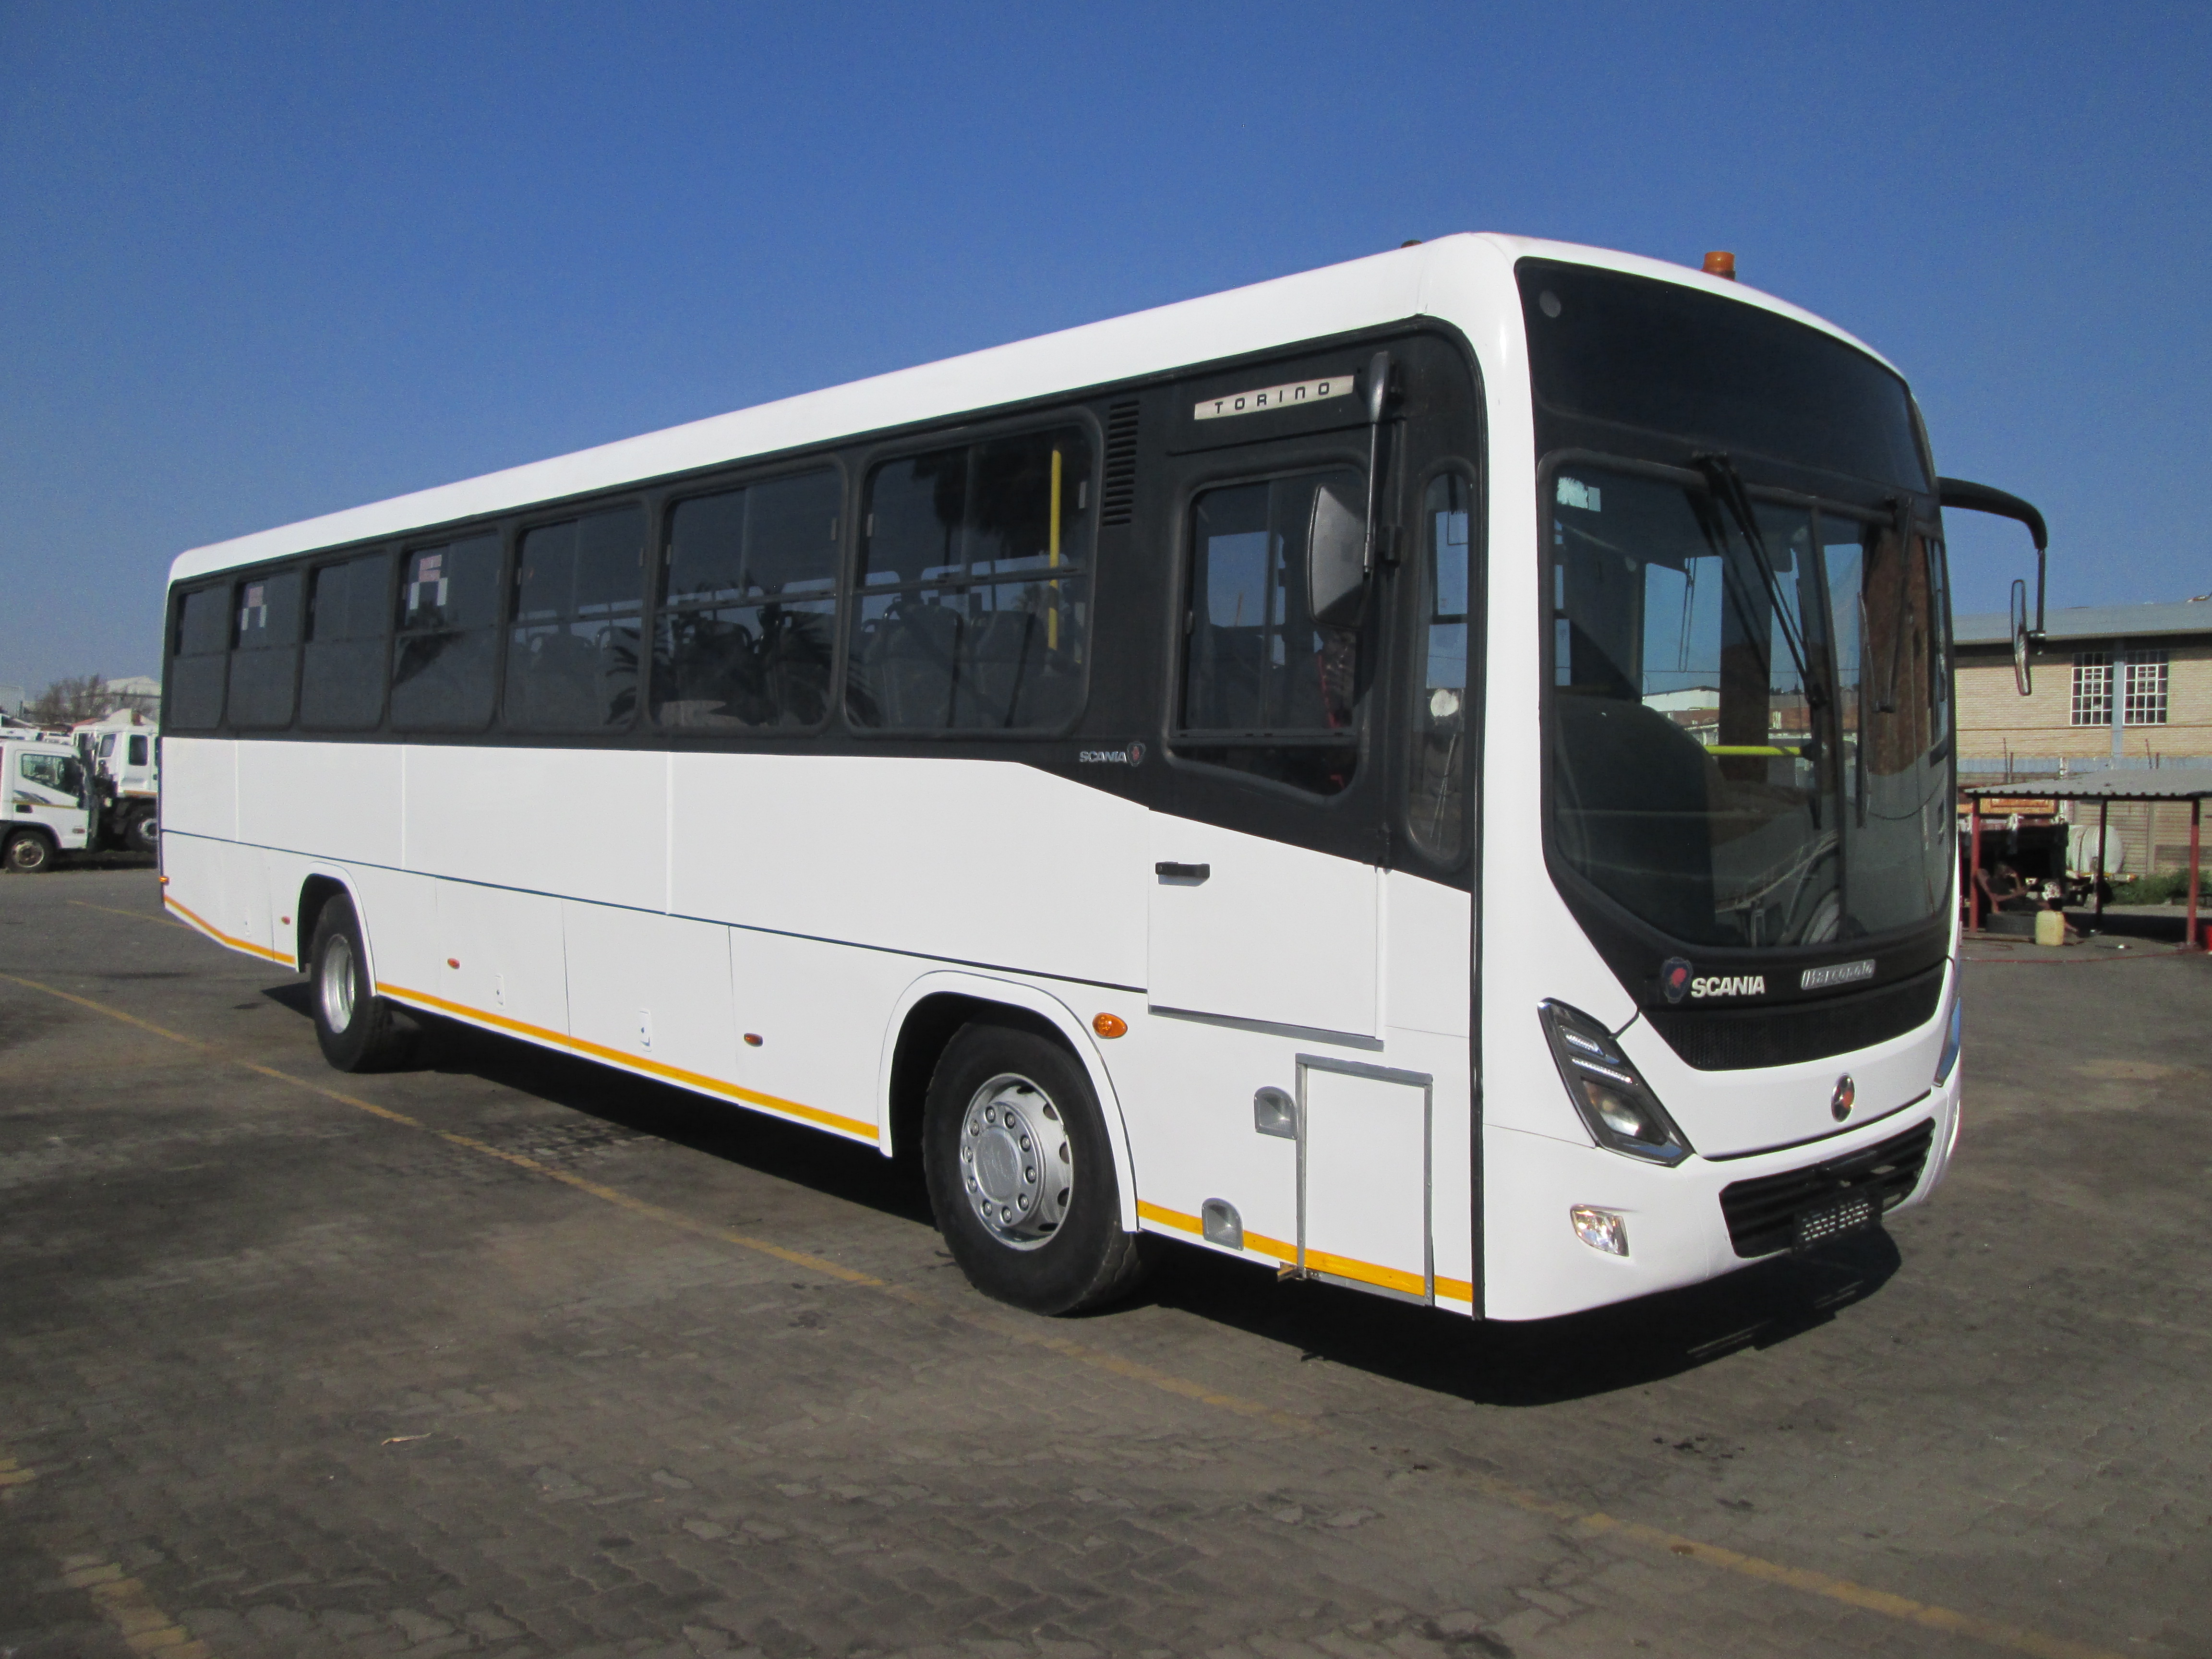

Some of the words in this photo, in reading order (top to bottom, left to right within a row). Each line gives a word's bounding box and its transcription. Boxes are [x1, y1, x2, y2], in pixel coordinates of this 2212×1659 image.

[1214, 382, 1330, 414] TORINO
[1079, 750, 1127, 763] SCANIA
[1691, 975, 1766, 998] SCANIA
